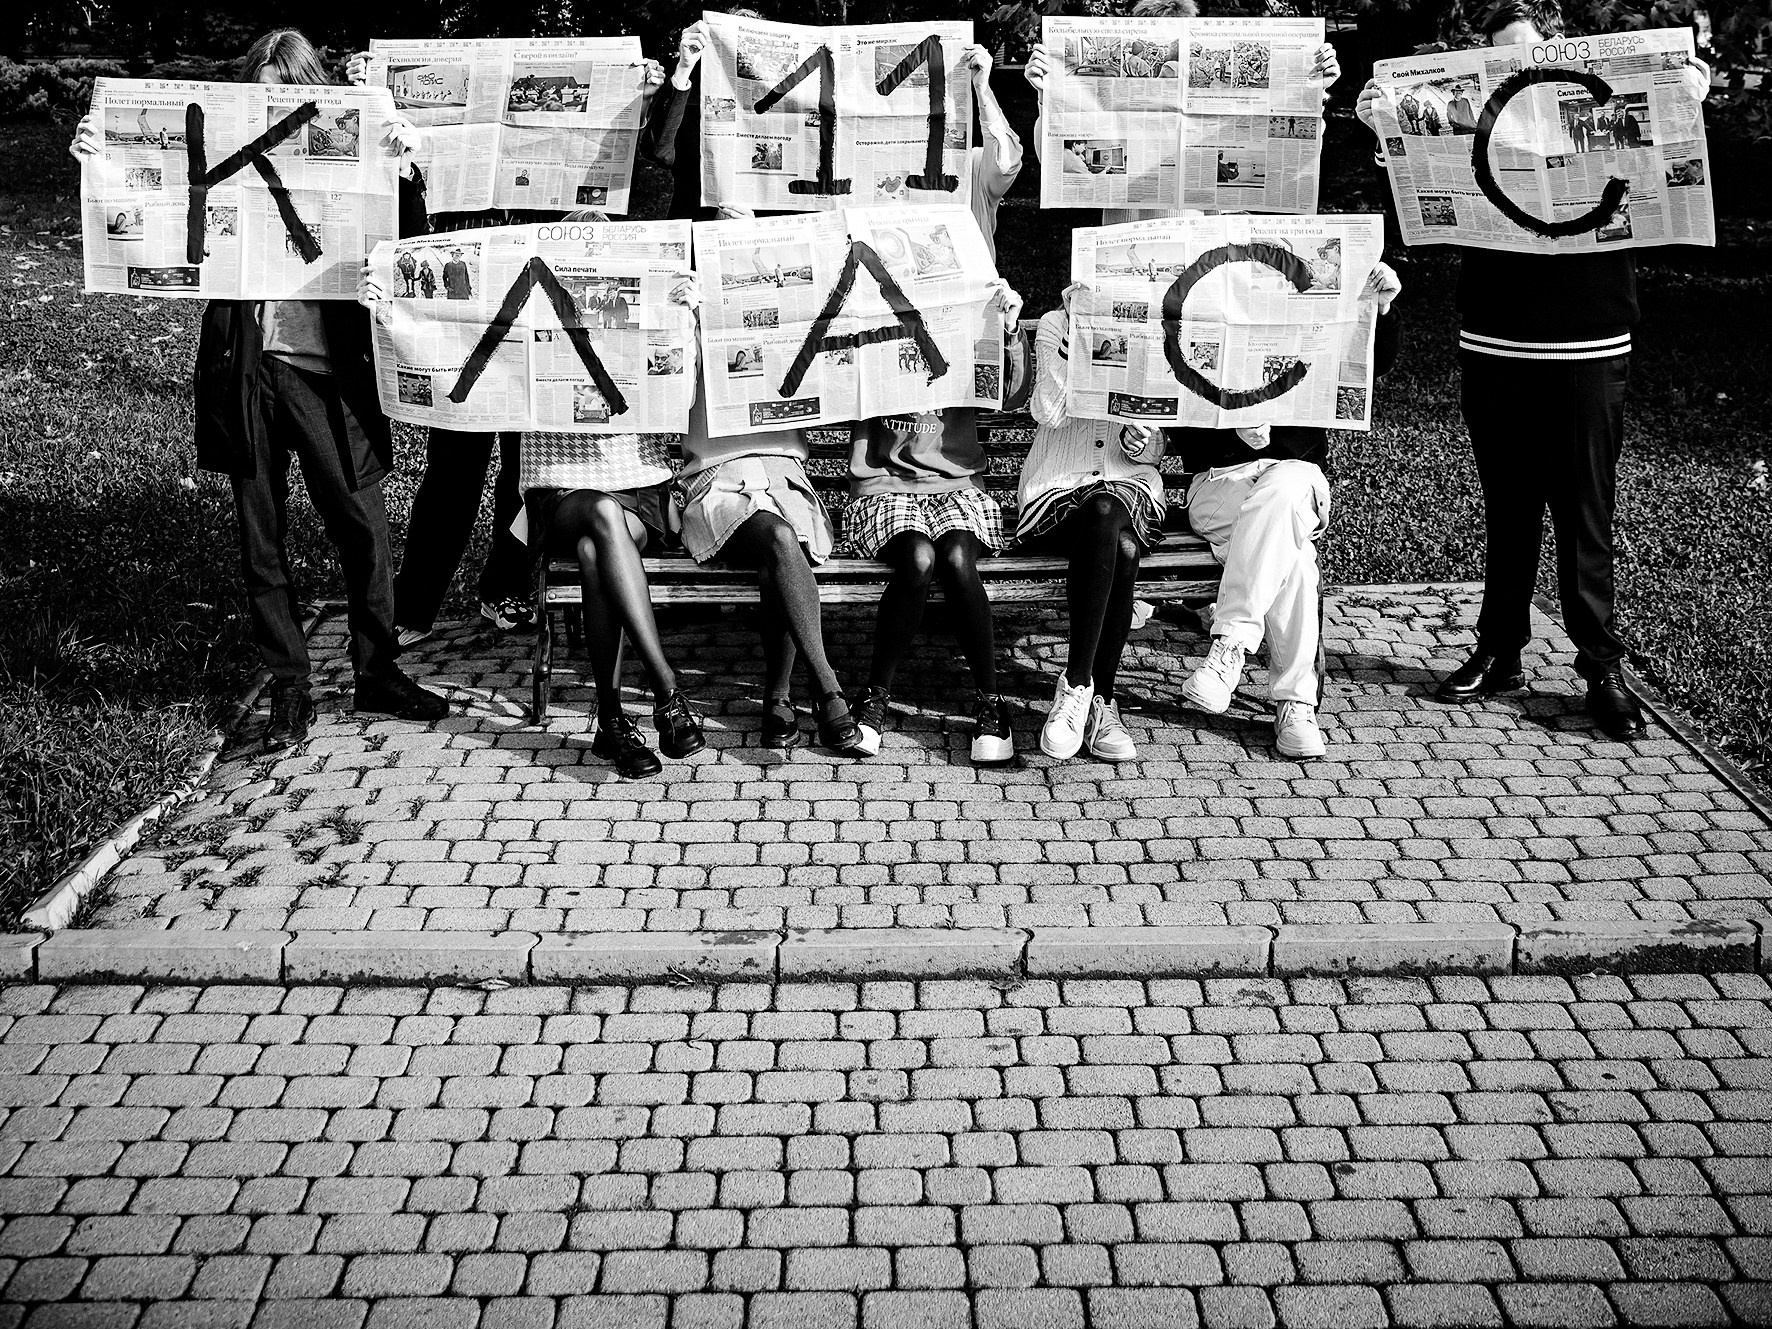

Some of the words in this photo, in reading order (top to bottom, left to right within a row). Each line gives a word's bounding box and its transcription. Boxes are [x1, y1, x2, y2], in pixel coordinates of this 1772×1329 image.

[1532, 41, 1590, 64] СОЮЗ
[1598, 35, 1645, 48] БЕЛАРУСЬ
[1599, 46, 1636, 57] РОССИЯ
[1392, 69, 1410, 79] Свой
[1409, 67, 1445, 77] Михалков
[1557, 89, 1575, 97] Сила
[104, 96, 130, 105] Полет
[131, 97, 185, 108] нормальный
[267, 94, 295, 105] Рецепт
[323, 99, 342, 107] года
[1471, 67, 1631, 239] С
[186, 101, 323, 264] К
[331, 193, 342, 201] 127
[537, 225, 594, 241] СОЮЗ
[602, 225, 647, 233] БЕЛАРУСЬ
[602, 233, 637, 241] РОССИЯ
[1250, 227, 1278, 235] Рецепт
[554, 265, 572, 273] Сила
[777, 233, 951, 399] А
[1162, 241, 1315, 410] С
[445, 256, 630, 417] Л
[396, 363, 414, 371] Какие
[882, 418, 937, 434] ATTITUDE
